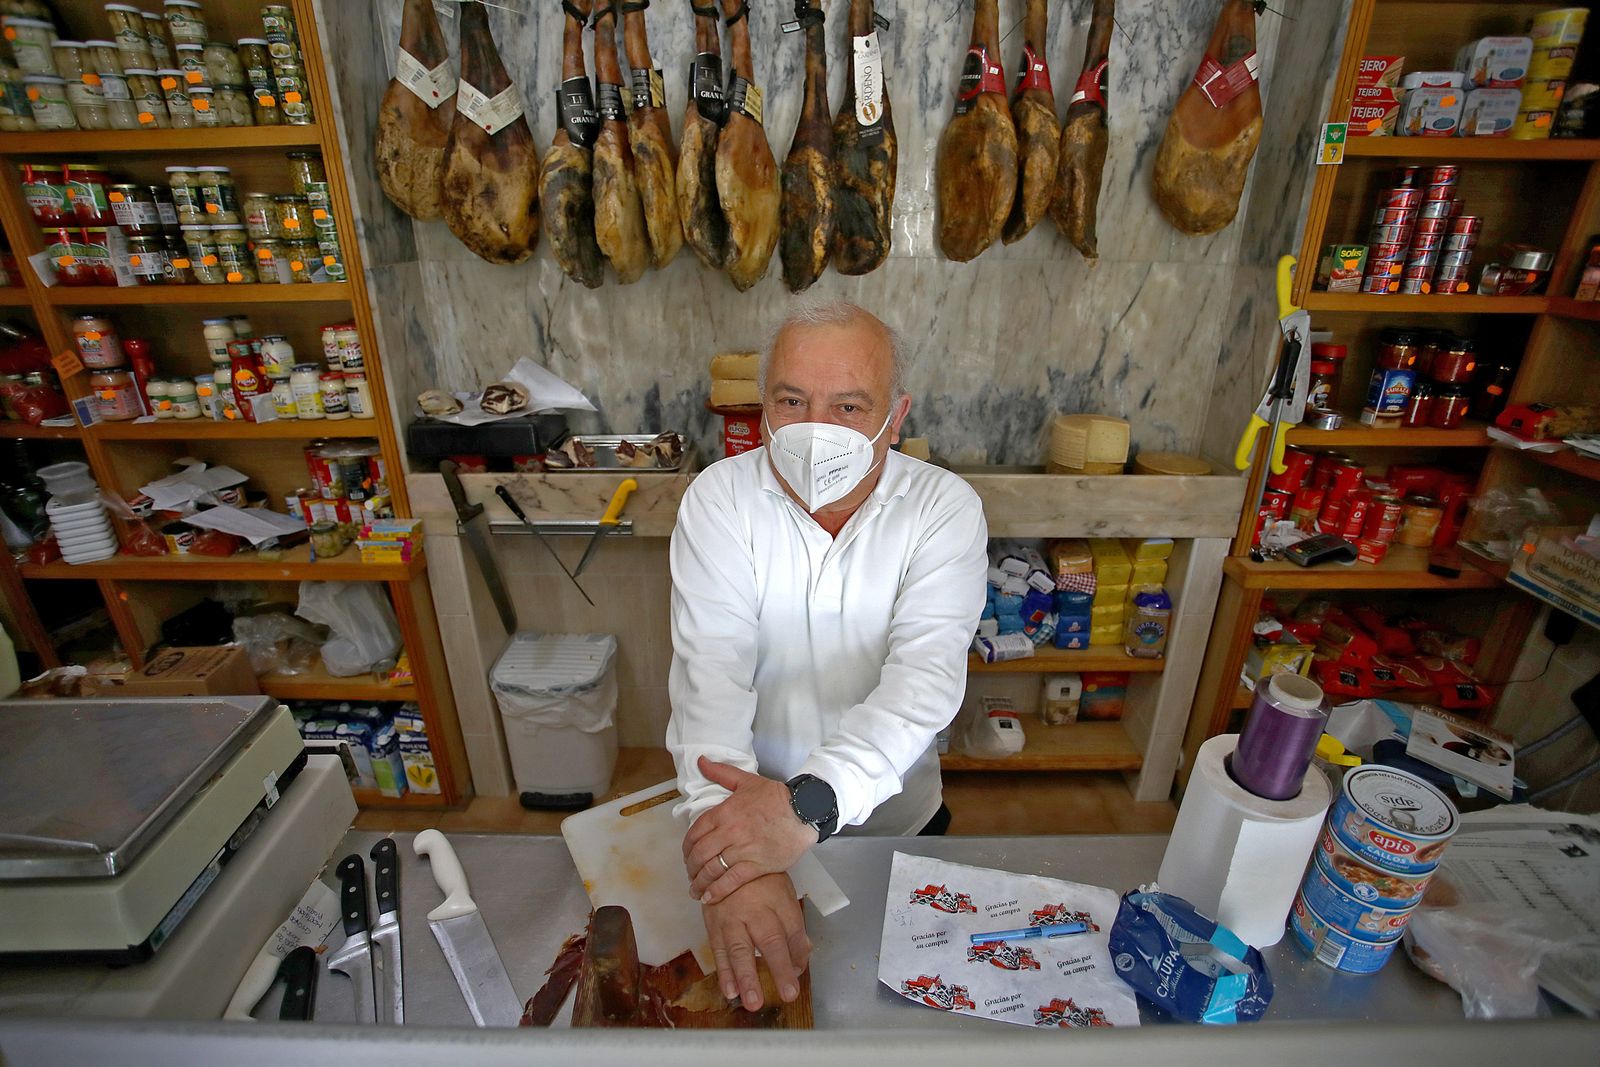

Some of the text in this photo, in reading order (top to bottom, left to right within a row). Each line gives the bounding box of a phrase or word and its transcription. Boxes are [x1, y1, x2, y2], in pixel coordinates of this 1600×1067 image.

[1359, 60, 1387, 72] EJERO
[1358, 88, 1382, 97] TEJERO
[1352, 106, 1385, 119] TEJERO
[1374, 833, 1413, 853] apis
[1366, 845, 1408, 865] CALLOS
[984, 899, 1019, 912] Gracias por
[911, 930, 947, 942] Gracias por
[925, 939, 948, 948] compra
[1056, 954, 1092, 969] Gracias por
[1073, 964, 1096, 975] compra
[984, 993, 1022, 1007] Gracias por
[999, 1003, 1025, 1014] compra
